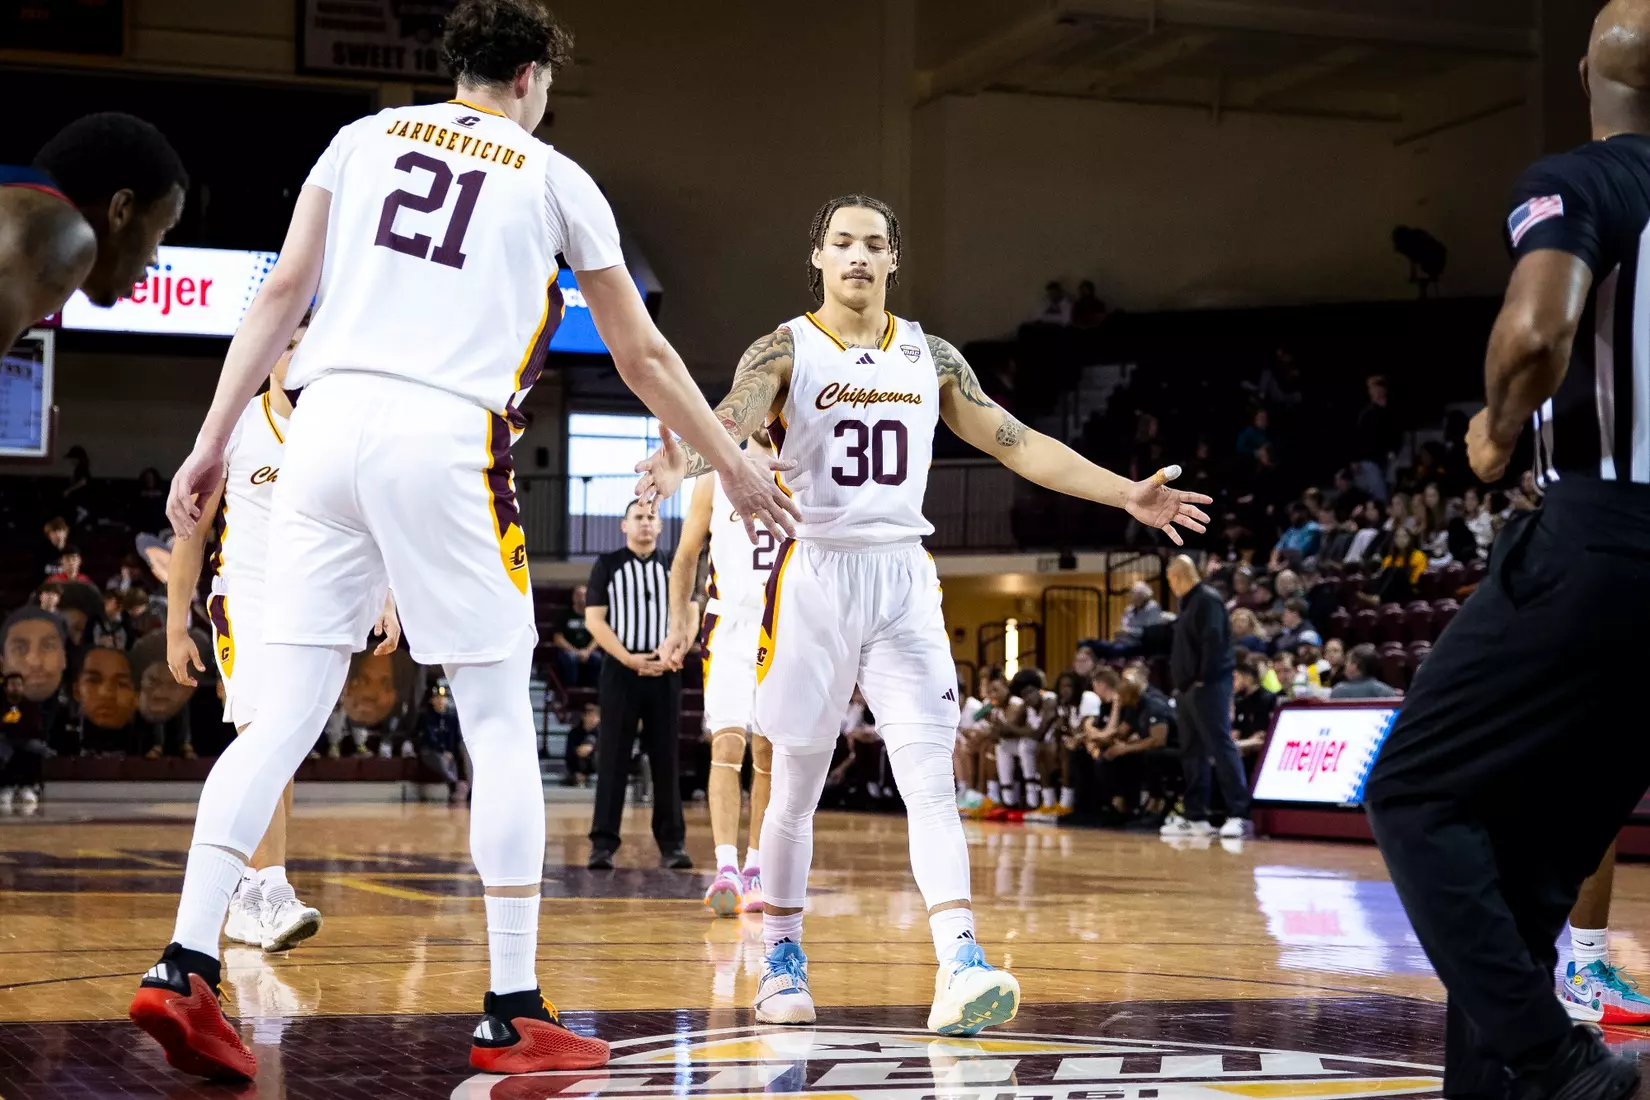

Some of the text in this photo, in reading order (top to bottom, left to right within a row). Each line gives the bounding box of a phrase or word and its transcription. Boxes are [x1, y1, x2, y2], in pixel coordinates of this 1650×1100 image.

[333, 42, 405, 69] SWEET
[386, 120, 526, 169] JARUSEVICIUS
[374, 151, 487, 270] 21
[117, 264, 213, 315] eijer
[815, 382, 922, 410] Chippewas
[831, 419, 908, 487] 30
[1277, 728, 1348, 784] meijer
